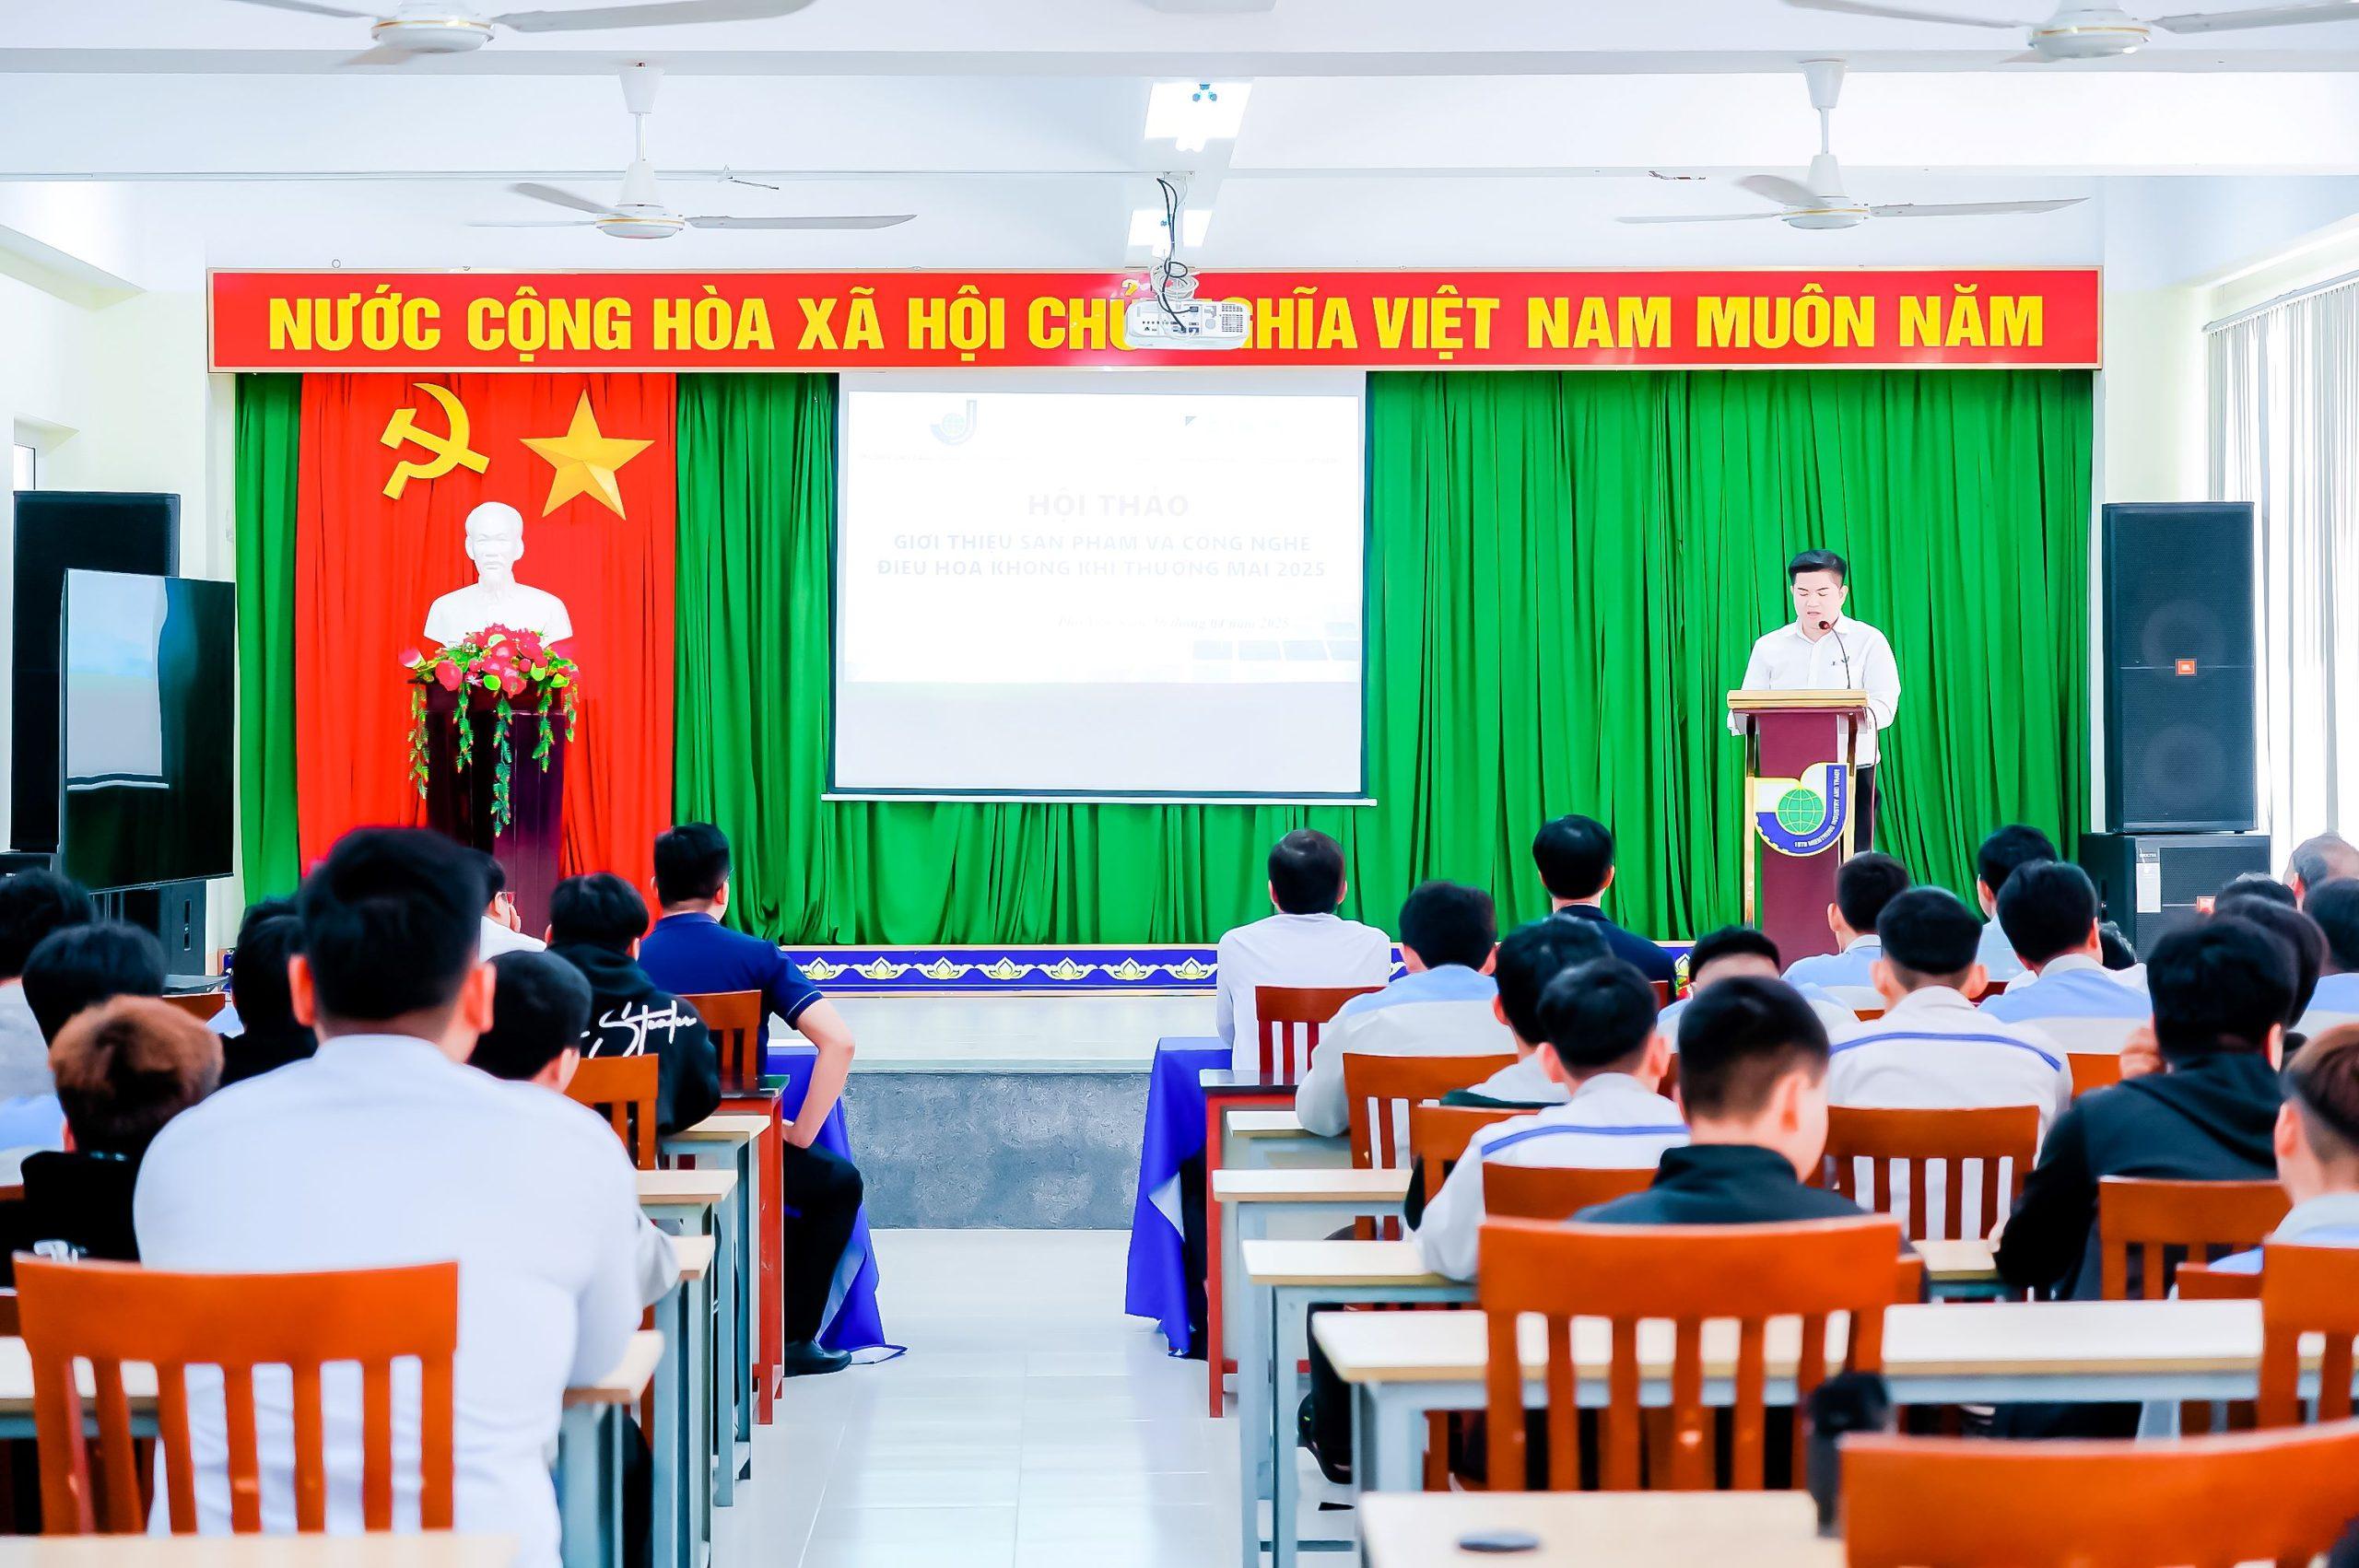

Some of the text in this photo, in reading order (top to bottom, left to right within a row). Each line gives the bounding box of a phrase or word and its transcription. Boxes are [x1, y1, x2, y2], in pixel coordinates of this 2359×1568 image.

[269, 284, 440, 351] NƯỚC
[467, 286, 631, 362] CỘNG
[653, 285, 775, 351] HÒA
[797, 287, 884, 350] XÃ
[909, 285, 1005, 361] HỘI
[1372, 284, 1500, 360] VIỆT
[1528, 297, 1672, 348] NAM
[1696, 283, 1875, 349] MUÔN
[1899, 283, 2043, 347] NĂM
[1276, 561, 1326, 578] 2025
